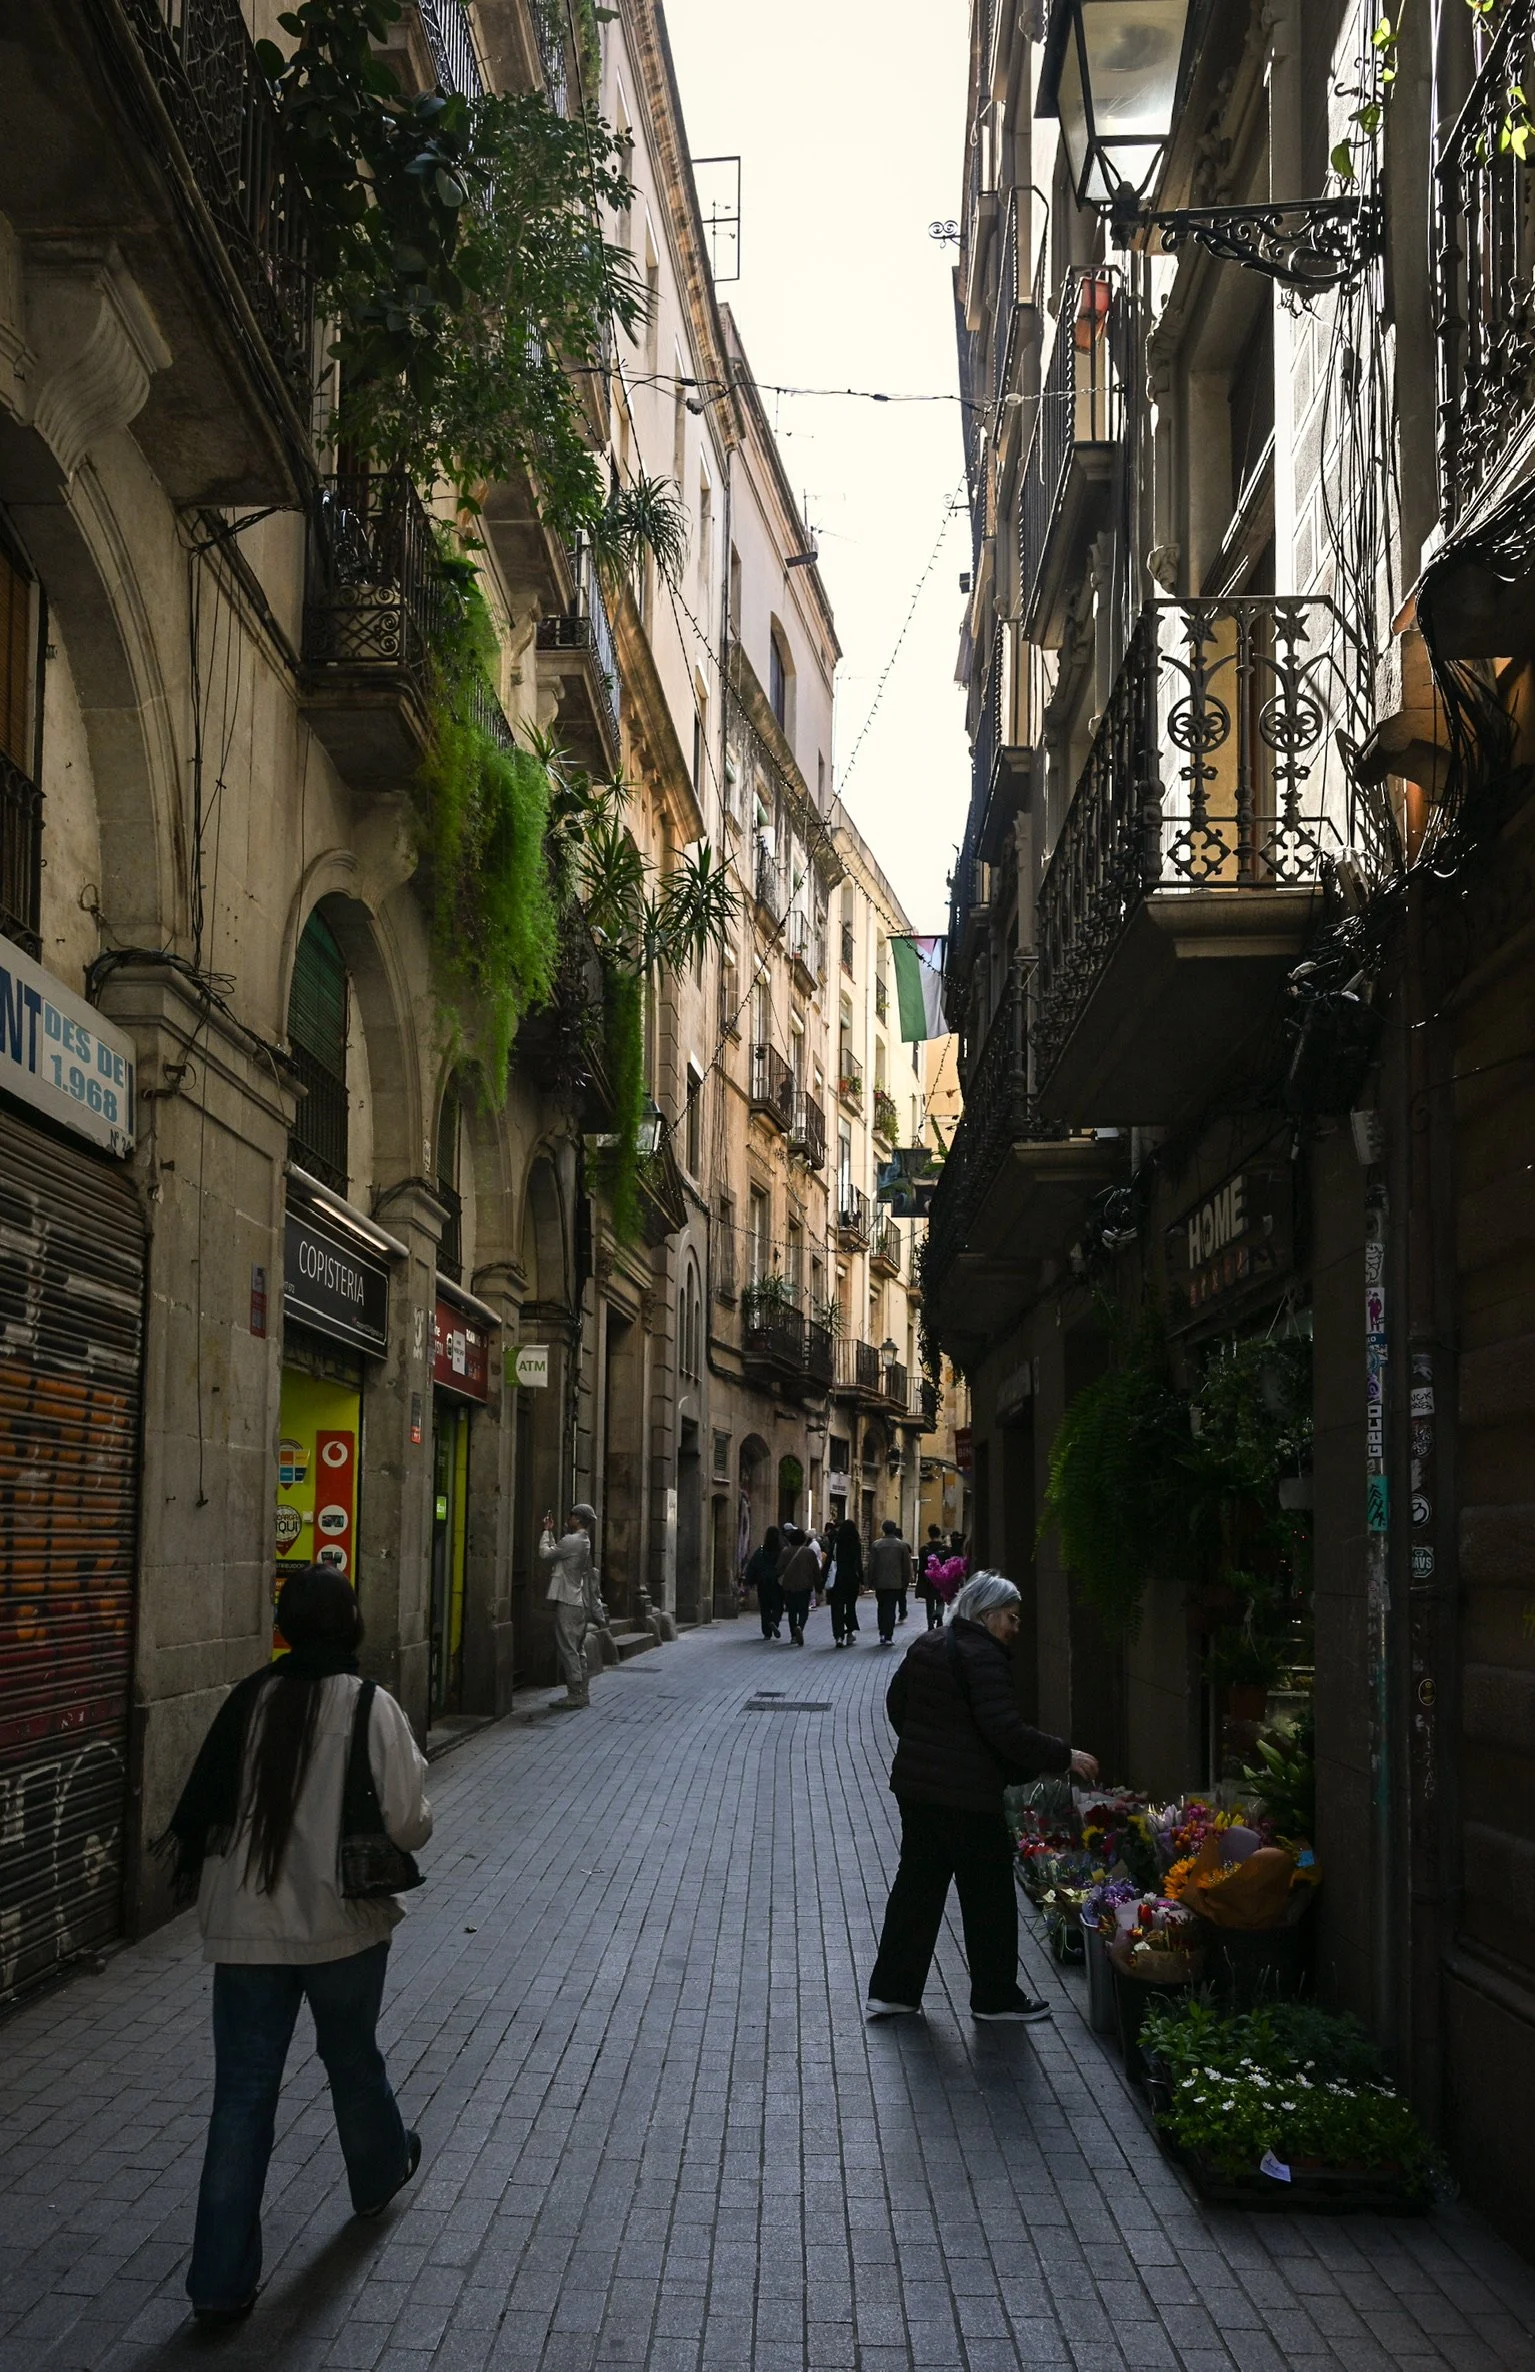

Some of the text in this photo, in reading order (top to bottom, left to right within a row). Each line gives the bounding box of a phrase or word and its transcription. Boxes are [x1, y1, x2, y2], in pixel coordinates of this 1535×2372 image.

[44, 1004, 124, 1089] DES DE
[50, 1054, 118, 1123] 1.968
[1188, 1174, 1245, 1269] HOME
[298, 1240, 366, 1307] COPISTERIA
[518, 1360, 547, 1373] ATM
[275, 1520, 298, 1535] QUI
